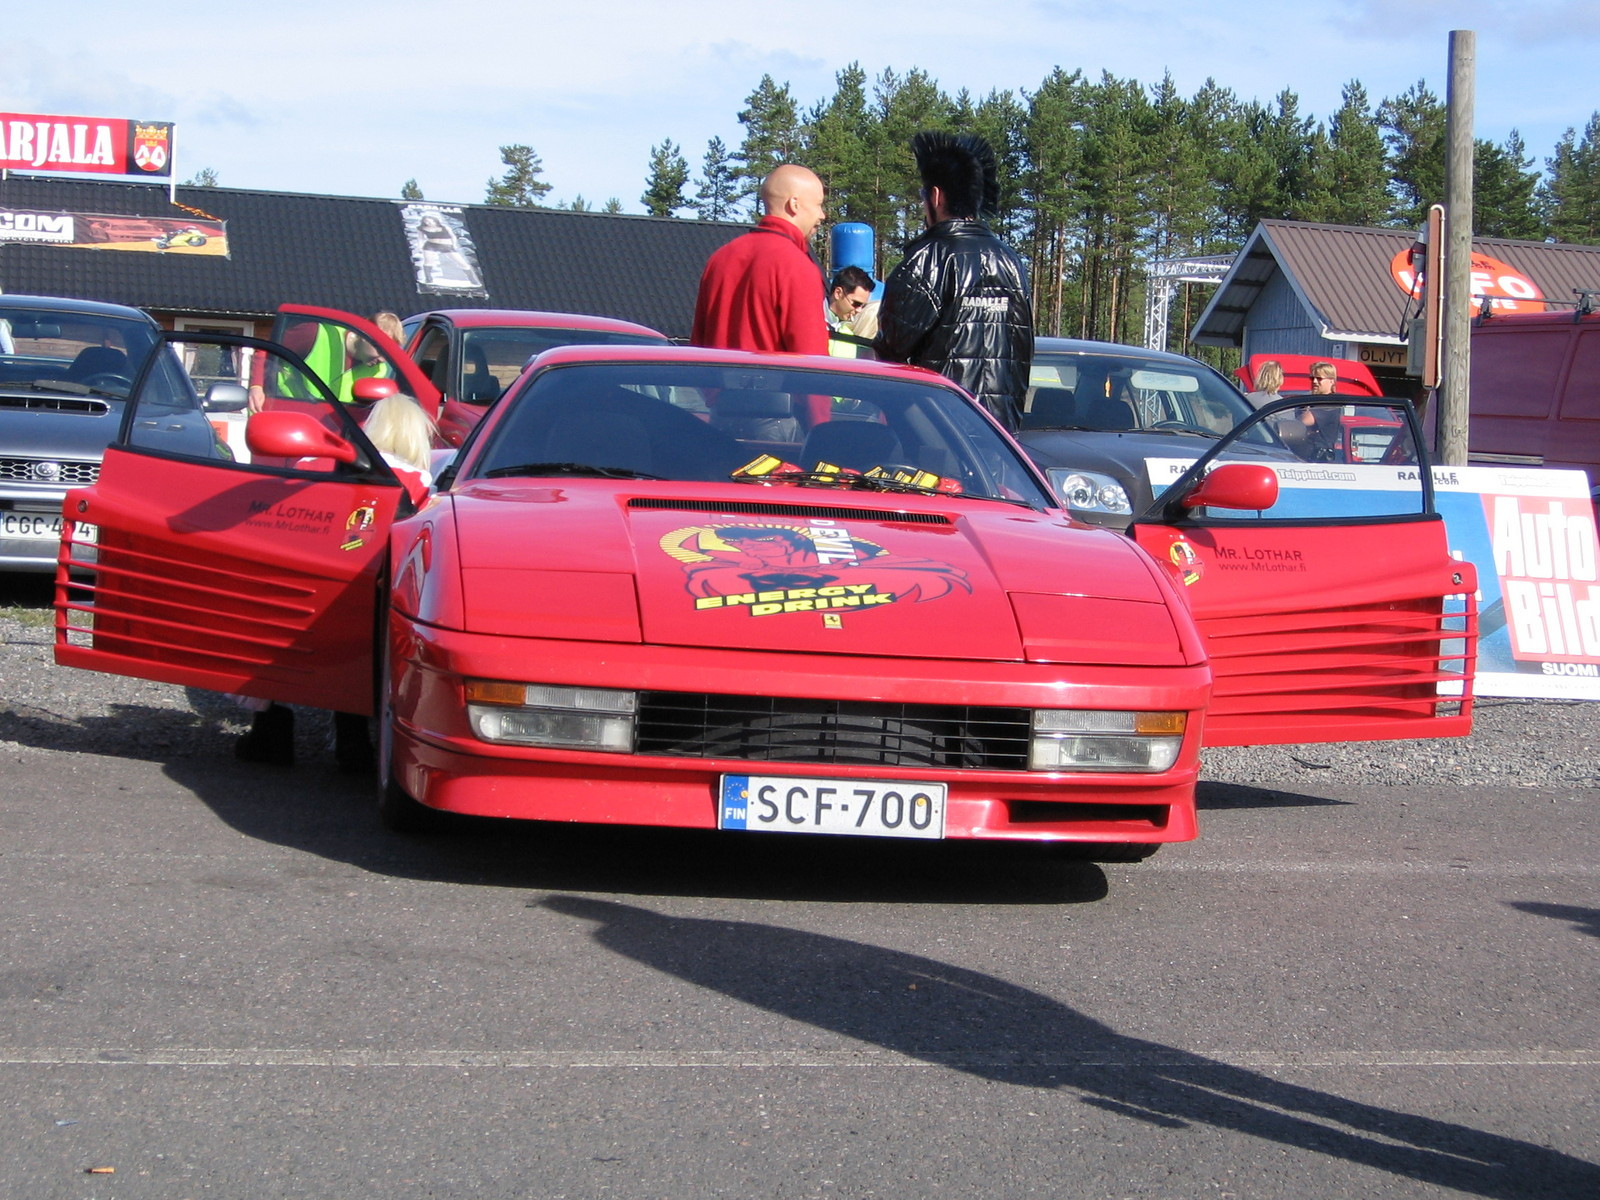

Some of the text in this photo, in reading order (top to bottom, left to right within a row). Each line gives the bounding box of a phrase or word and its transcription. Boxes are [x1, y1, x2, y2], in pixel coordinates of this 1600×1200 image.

[1398, 271, 1536, 299] IFO
[961, 296, 1009, 307] RADALLE
[1360, 346, 1405, 364] ÖLJYT
[1397, 471, 1457, 481] RALLE
[276, 504, 335, 523] LOTHAR
[1493, 496, 1597, 582] Auto
[1213, 546, 1303, 561] MR. LOTHAR
[1219, 562, 1307, 573] www.MrLothar.fi
[695, 583, 874, 610] ENERGY
[750, 593, 893, 617] DRINK
[1506, 580, 1600, 657] Bild
[1541, 662, 1599, 677] SUOMI
[725, 807, 746, 820] FIN
